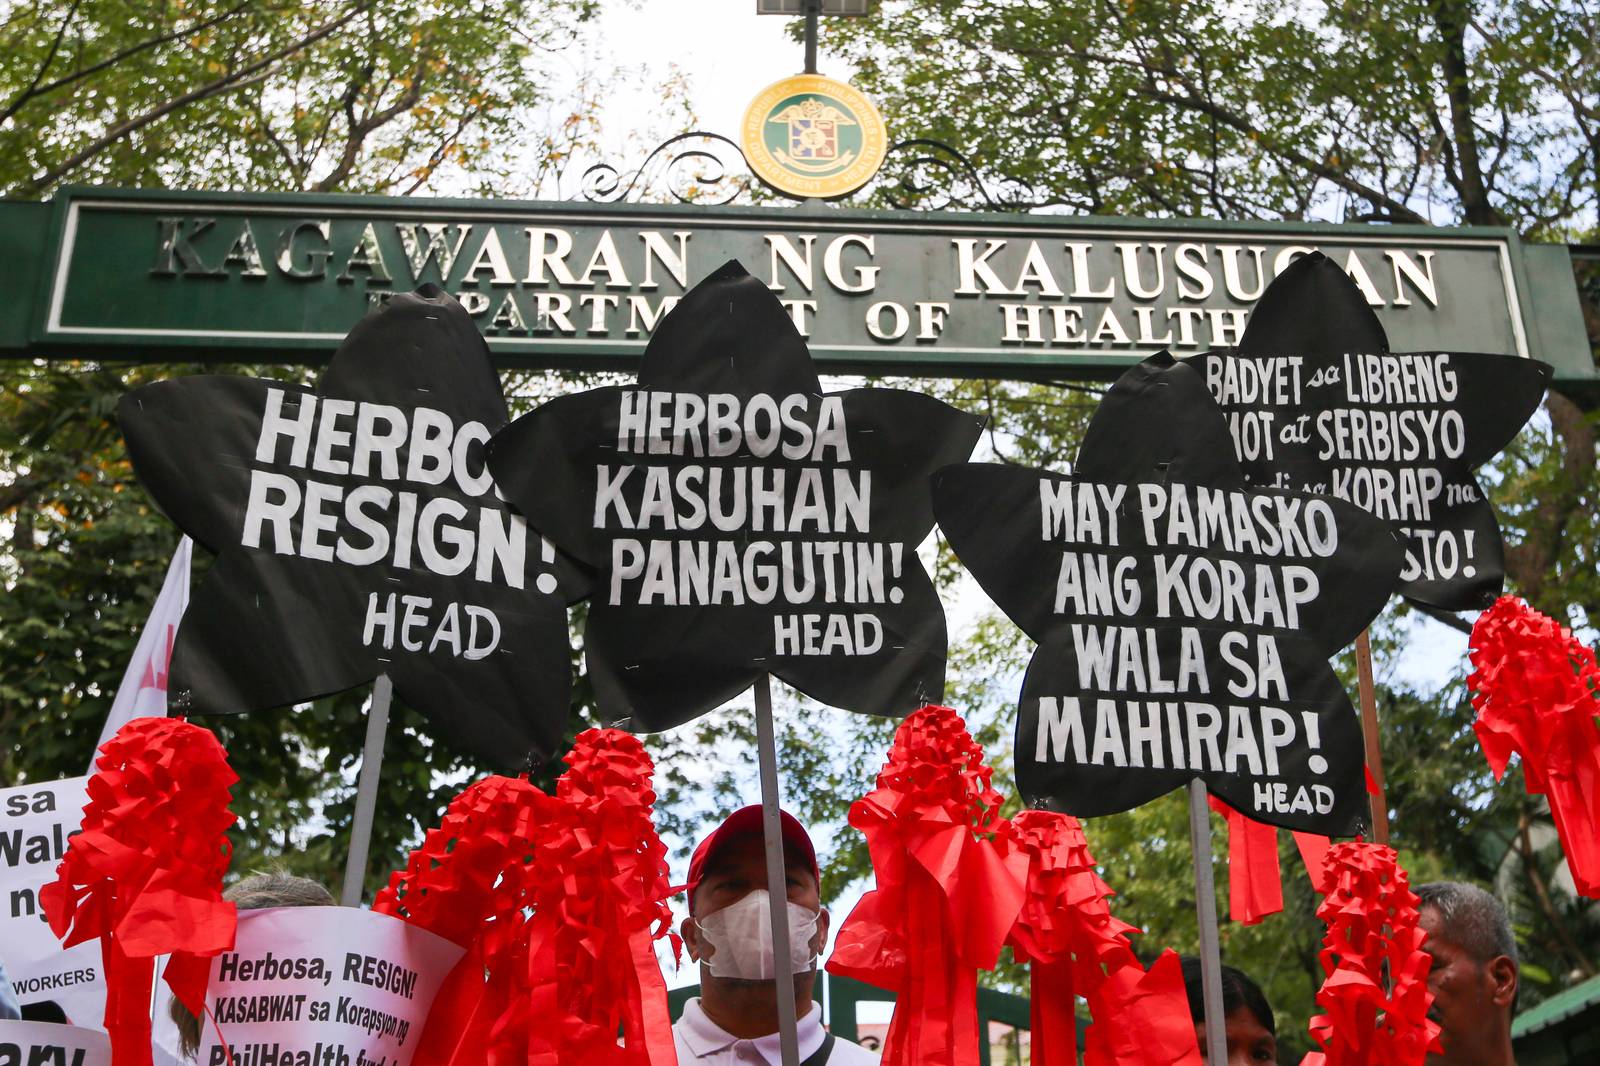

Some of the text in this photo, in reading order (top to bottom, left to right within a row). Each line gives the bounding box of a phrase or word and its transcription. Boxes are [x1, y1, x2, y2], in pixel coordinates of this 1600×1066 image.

[151, 217, 1440, 309] KAGAWARAN NG KALUSUAN
[864, 301, 950, 341] OF
[999, 303, 1250, 347] HEALTH
[1207, 353, 1459, 405] BADYET sa LIBRENG
[255, 387, 506, 502] HERBO
[617, 390, 852, 463] HERBOSA
[1279, 414, 1312, 444] at
[1316, 408, 1466, 461] SERBISYO
[593, 464, 872, 534] KASUHAN
[1039, 478, 1339, 558] MAY PAMASKO
[1332, 466, 1443, 522] KORAP
[1446, 483, 1481, 507] na
[241, 469, 559, 595] RESIGN!
[608, 538, 906, 606] PANAGUTIN!
[1053, 551, 1321, 630] ANG KORAP
[362, 592, 502, 661] HEAD
[773, 613, 884, 656] HEAD
[1071, 623, 1290, 702] WALA SA
[1034, 695, 1330, 777] MAHIRAP!
[5, 790, 57, 818] sa
[1252, 782, 1336, 816] HEAD
[0, 823, 84, 868] Wal
[12, 967, 97, 996] WORKERS
[218, 951, 419, 1001] Herbosa, RESIGN!
[213, 994, 411, 1046] KASABWAT sa Korapsyon ng
